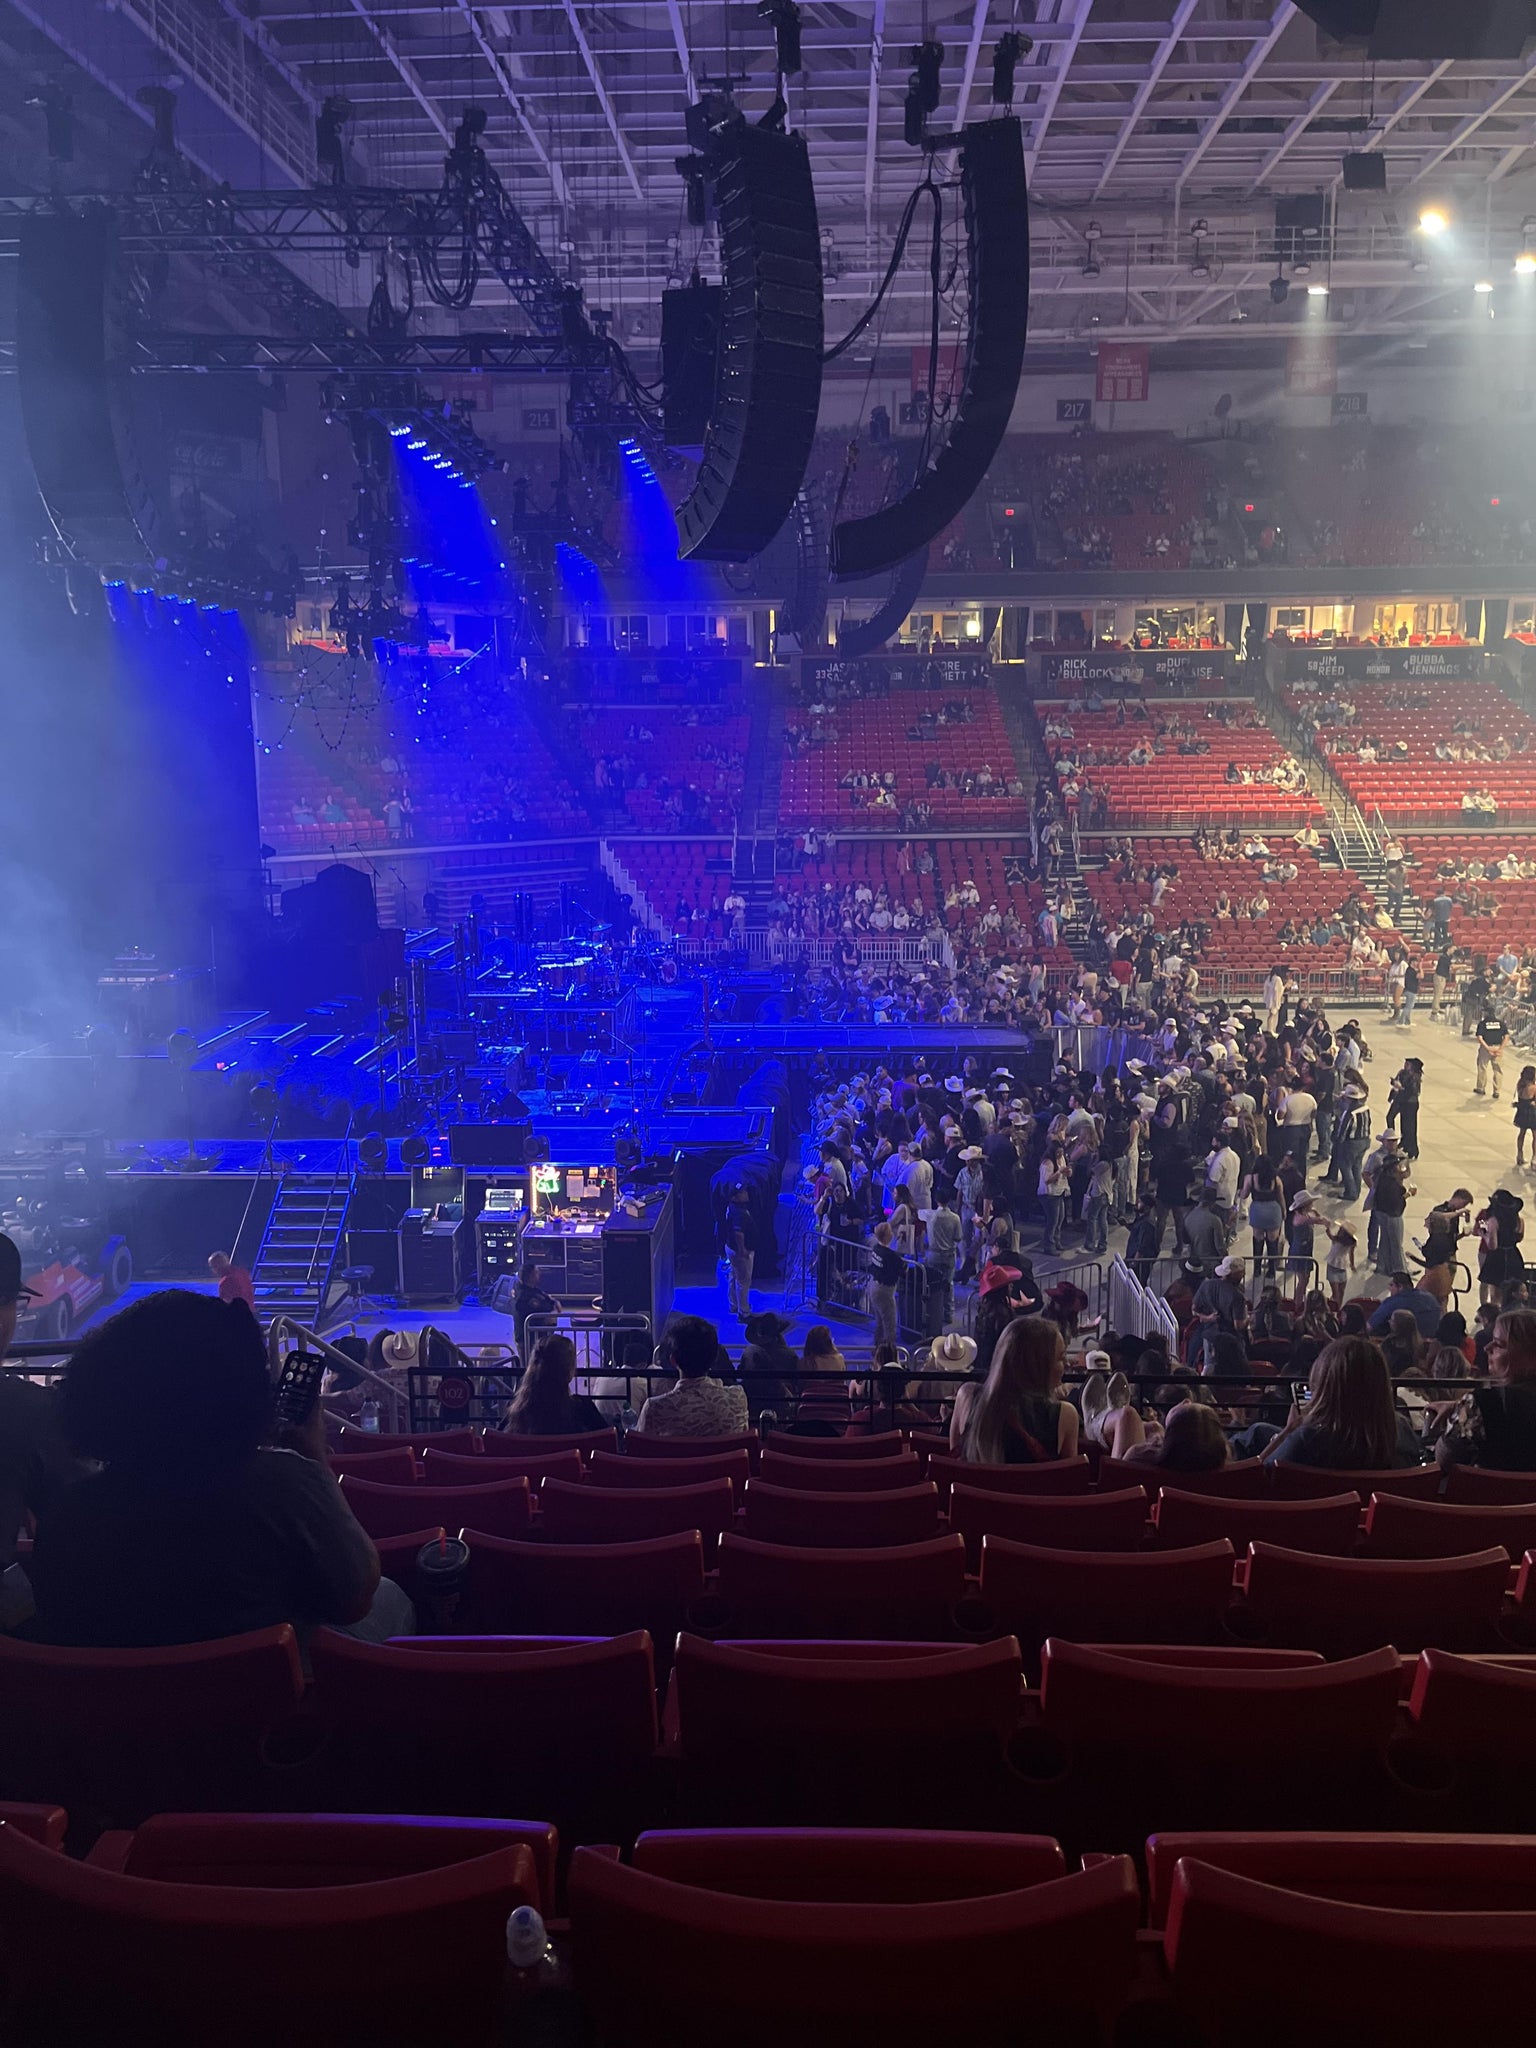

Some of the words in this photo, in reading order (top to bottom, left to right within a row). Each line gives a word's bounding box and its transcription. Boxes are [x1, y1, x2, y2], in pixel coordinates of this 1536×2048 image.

[1063, 402, 1085, 418] 217
[527, 412, 550, 427] 214
[1063, 659, 1087, 669] RICK
[1319, 656, 1337, 666] JIM
[1409, 655, 1445, 665] BUBBA
[815, 669, 826, 679] 33
[1318, 665, 1345, 676] REED
[1409, 664, 1461, 675] JENNINGS
[444, 1388, 464, 1399] 102
